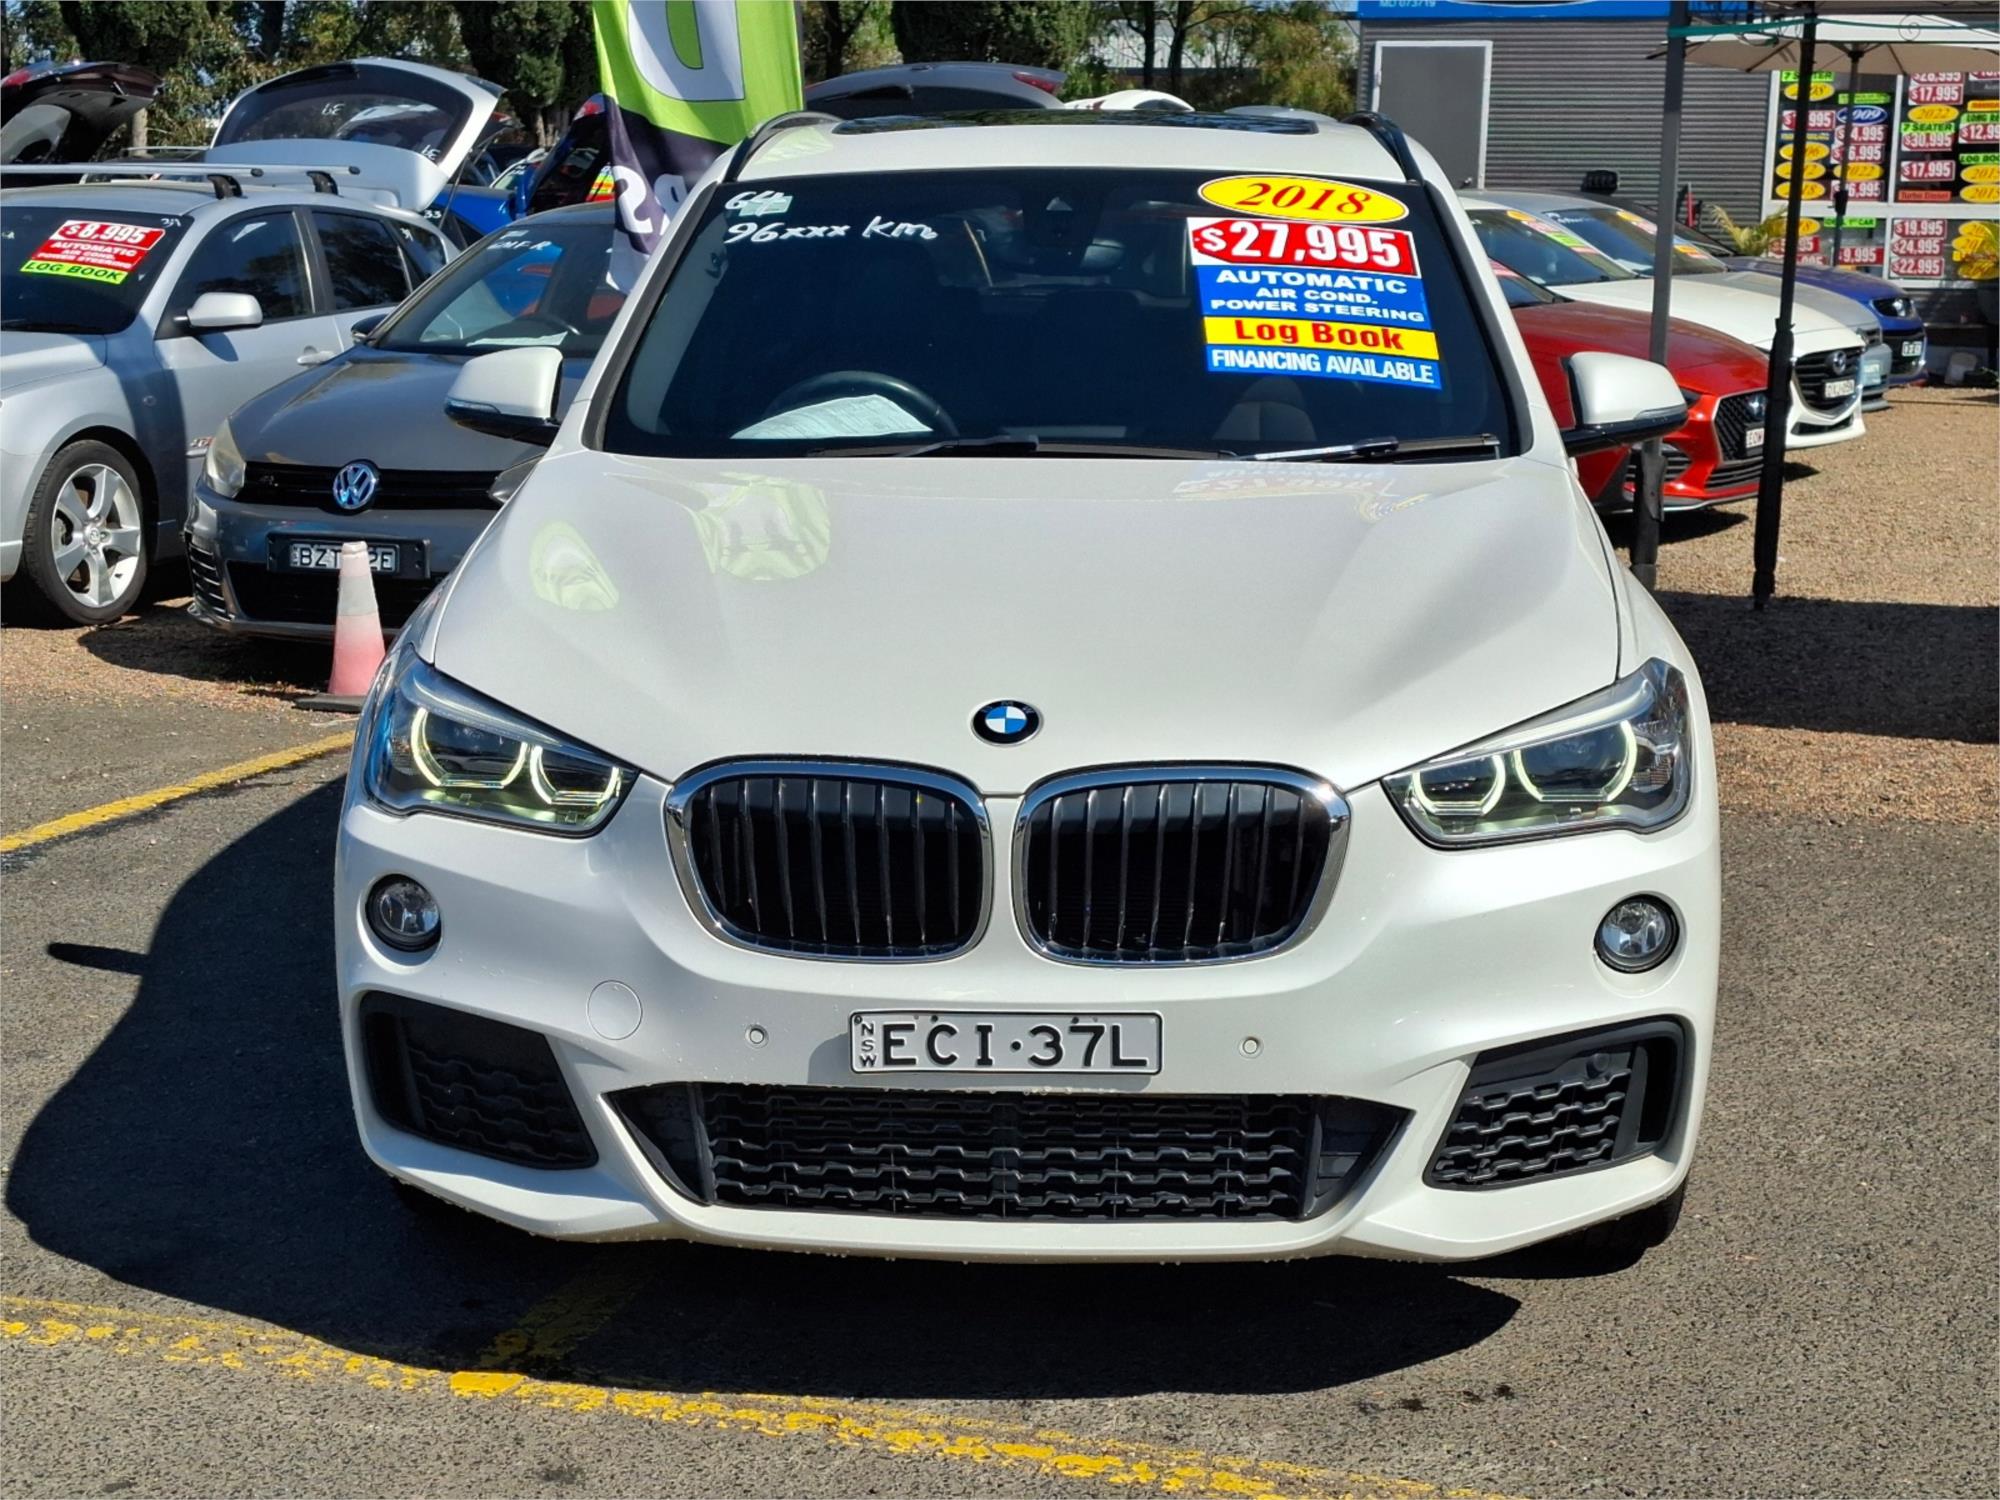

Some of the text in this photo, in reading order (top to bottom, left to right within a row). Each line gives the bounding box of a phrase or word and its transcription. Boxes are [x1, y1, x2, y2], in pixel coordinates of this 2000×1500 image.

[1911, 86, 1960, 102] $17,995
[1902, 161, 1951, 178] $17,995
[1235, 183, 1372, 215] 2018
[66, 222, 147, 245] $8,995
[1895, 220, 1943, 236] $19,995
[50, 241, 138, 257] AUTOMATIC
[1200, 220, 1401, 268] $27,995
[1892, 239, 1940, 255] $24,995
[25, 260, 124, 280] LOG BOOK
[1892, 258, 1940, 275] $22,995
[1216, 269, 1408, 295] AUTOMATIC
[1255, 287, 1379, 305] AIR COND.
[1210, 299, 1425, 323] POWER STEERING
[1235, 319, 1404, 351] Log Book
[1211, 348, 1435, 384] FINANCING AVAILABLE
